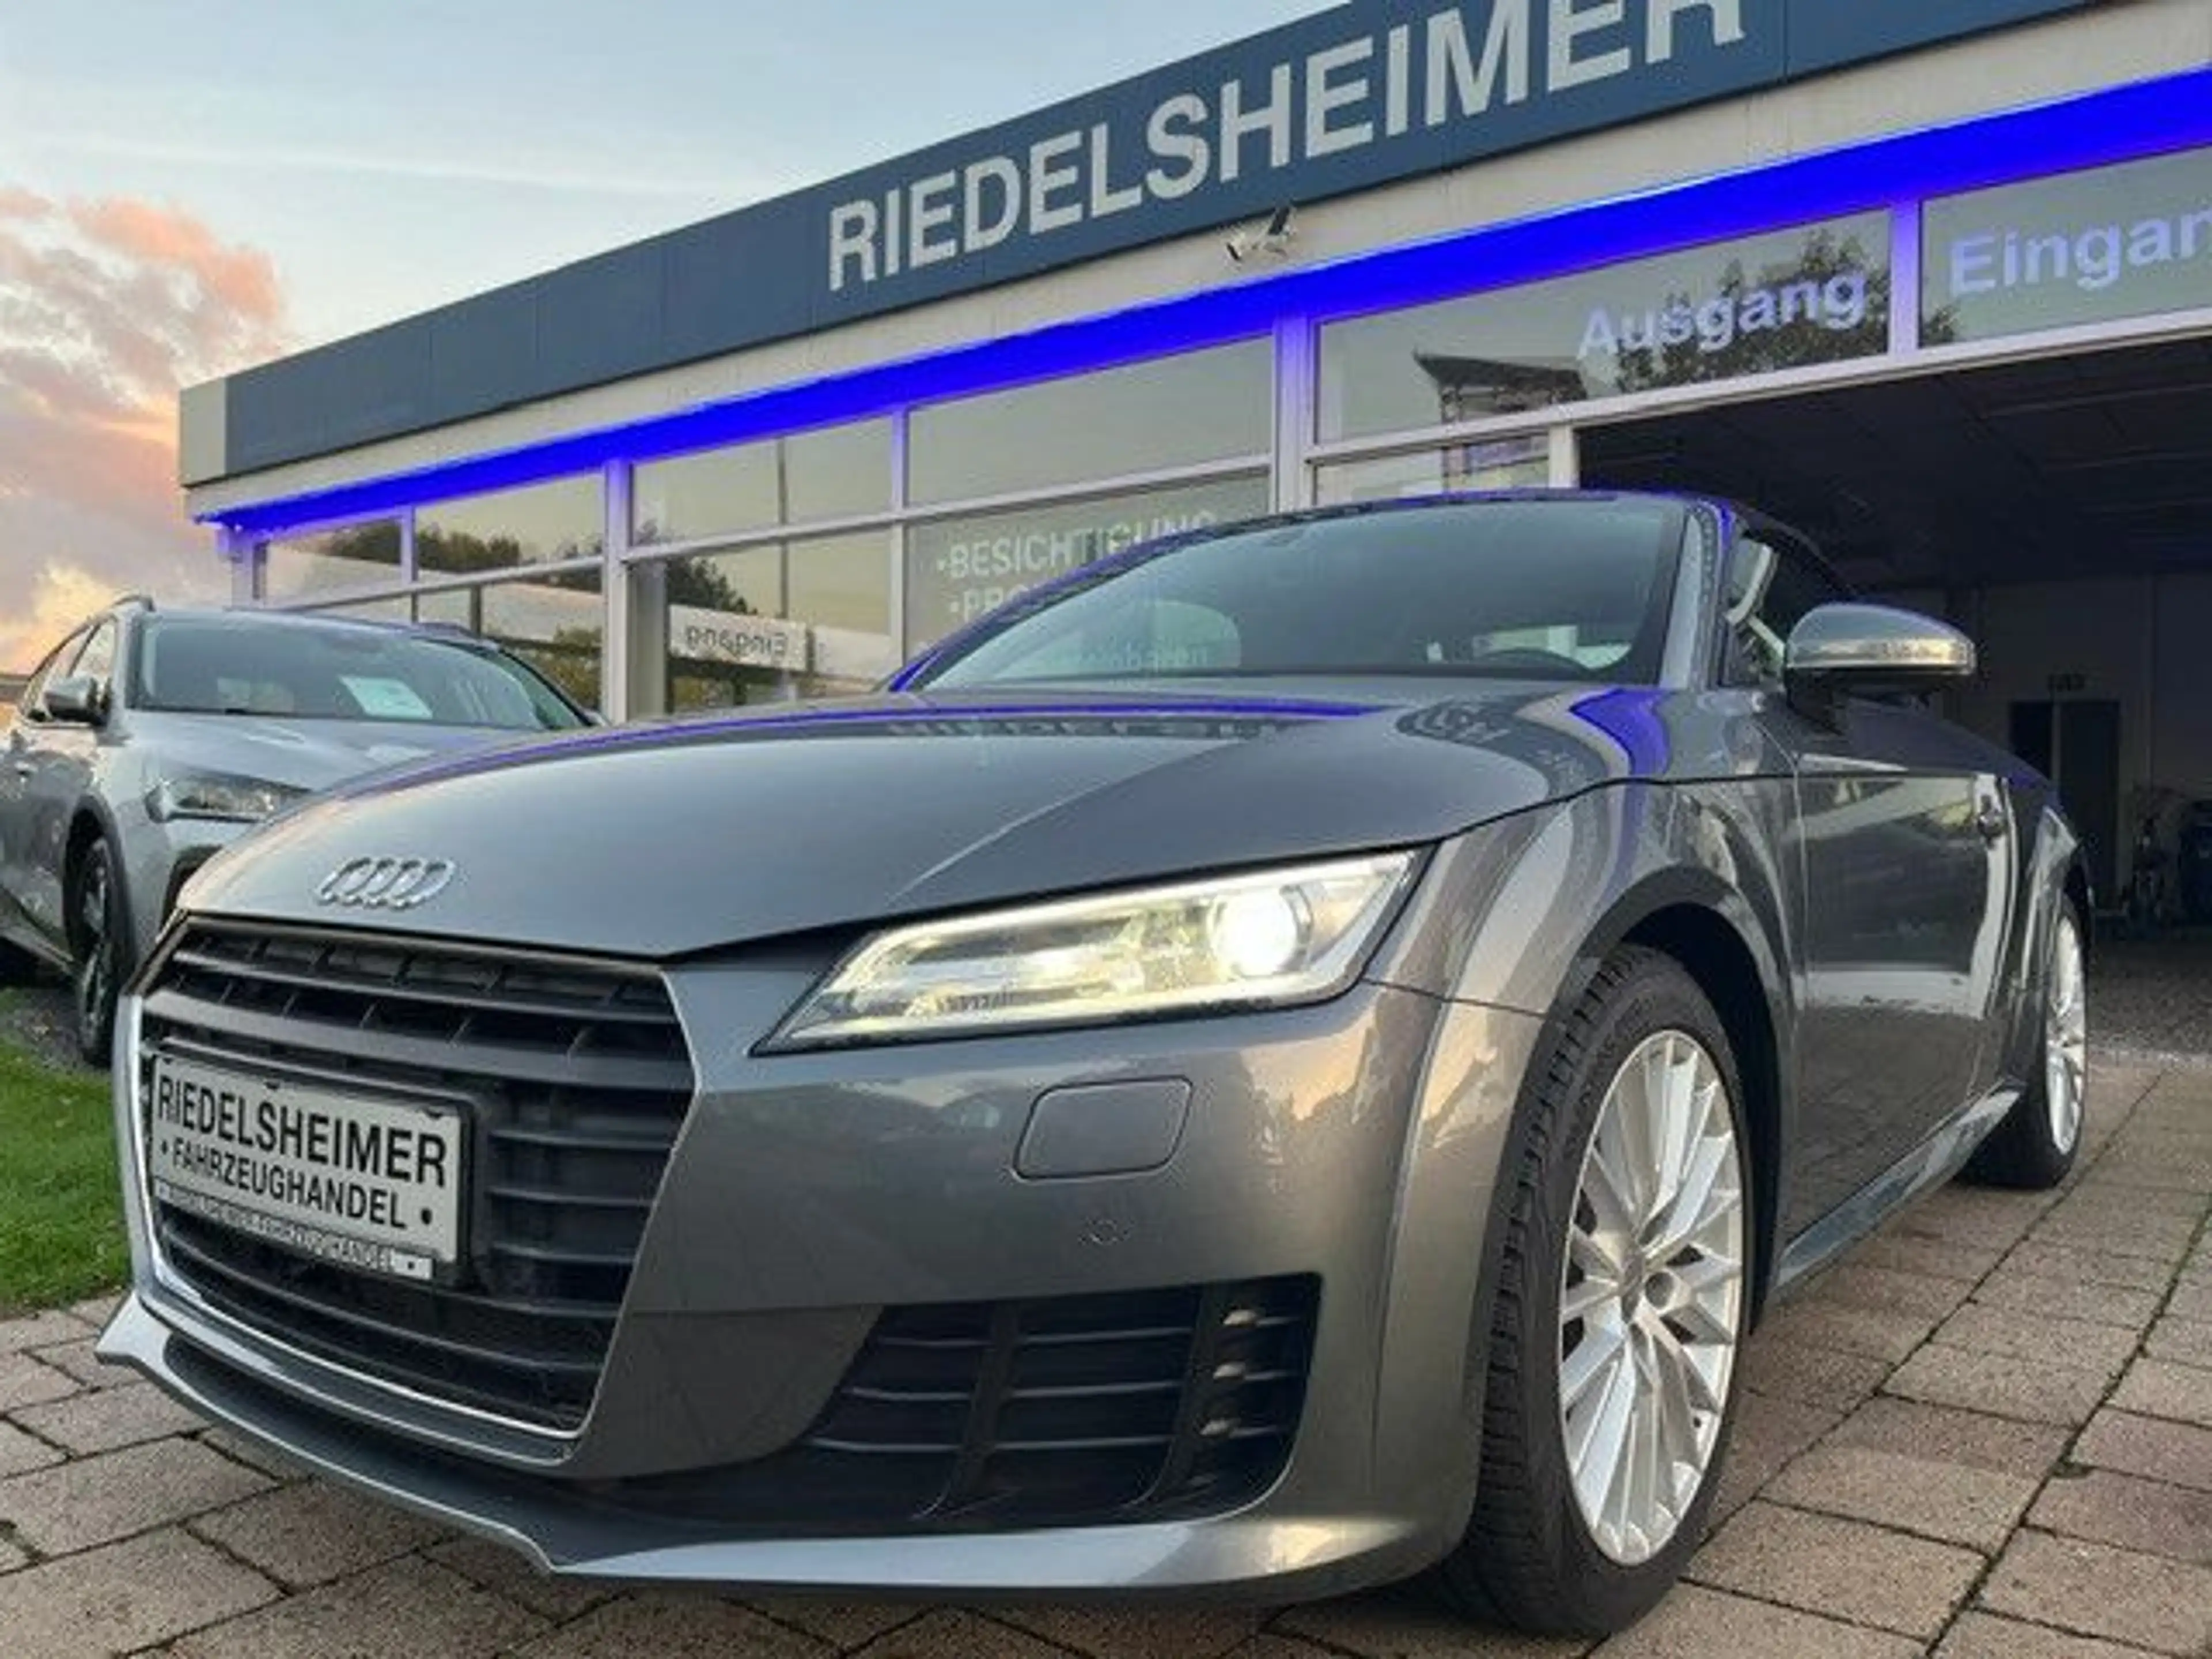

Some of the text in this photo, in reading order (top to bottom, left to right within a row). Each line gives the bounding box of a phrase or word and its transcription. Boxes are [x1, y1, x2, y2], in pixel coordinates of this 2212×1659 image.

[828, 0, 1745, 292] RIEDELSHEIMER
[1576, 266, 1866, 359] Ausgang
[158, 1074, 446, 1188] RIEDELSHEIMER
[173, 1136, 407, 1229] FAHRZEUGHANDEL
